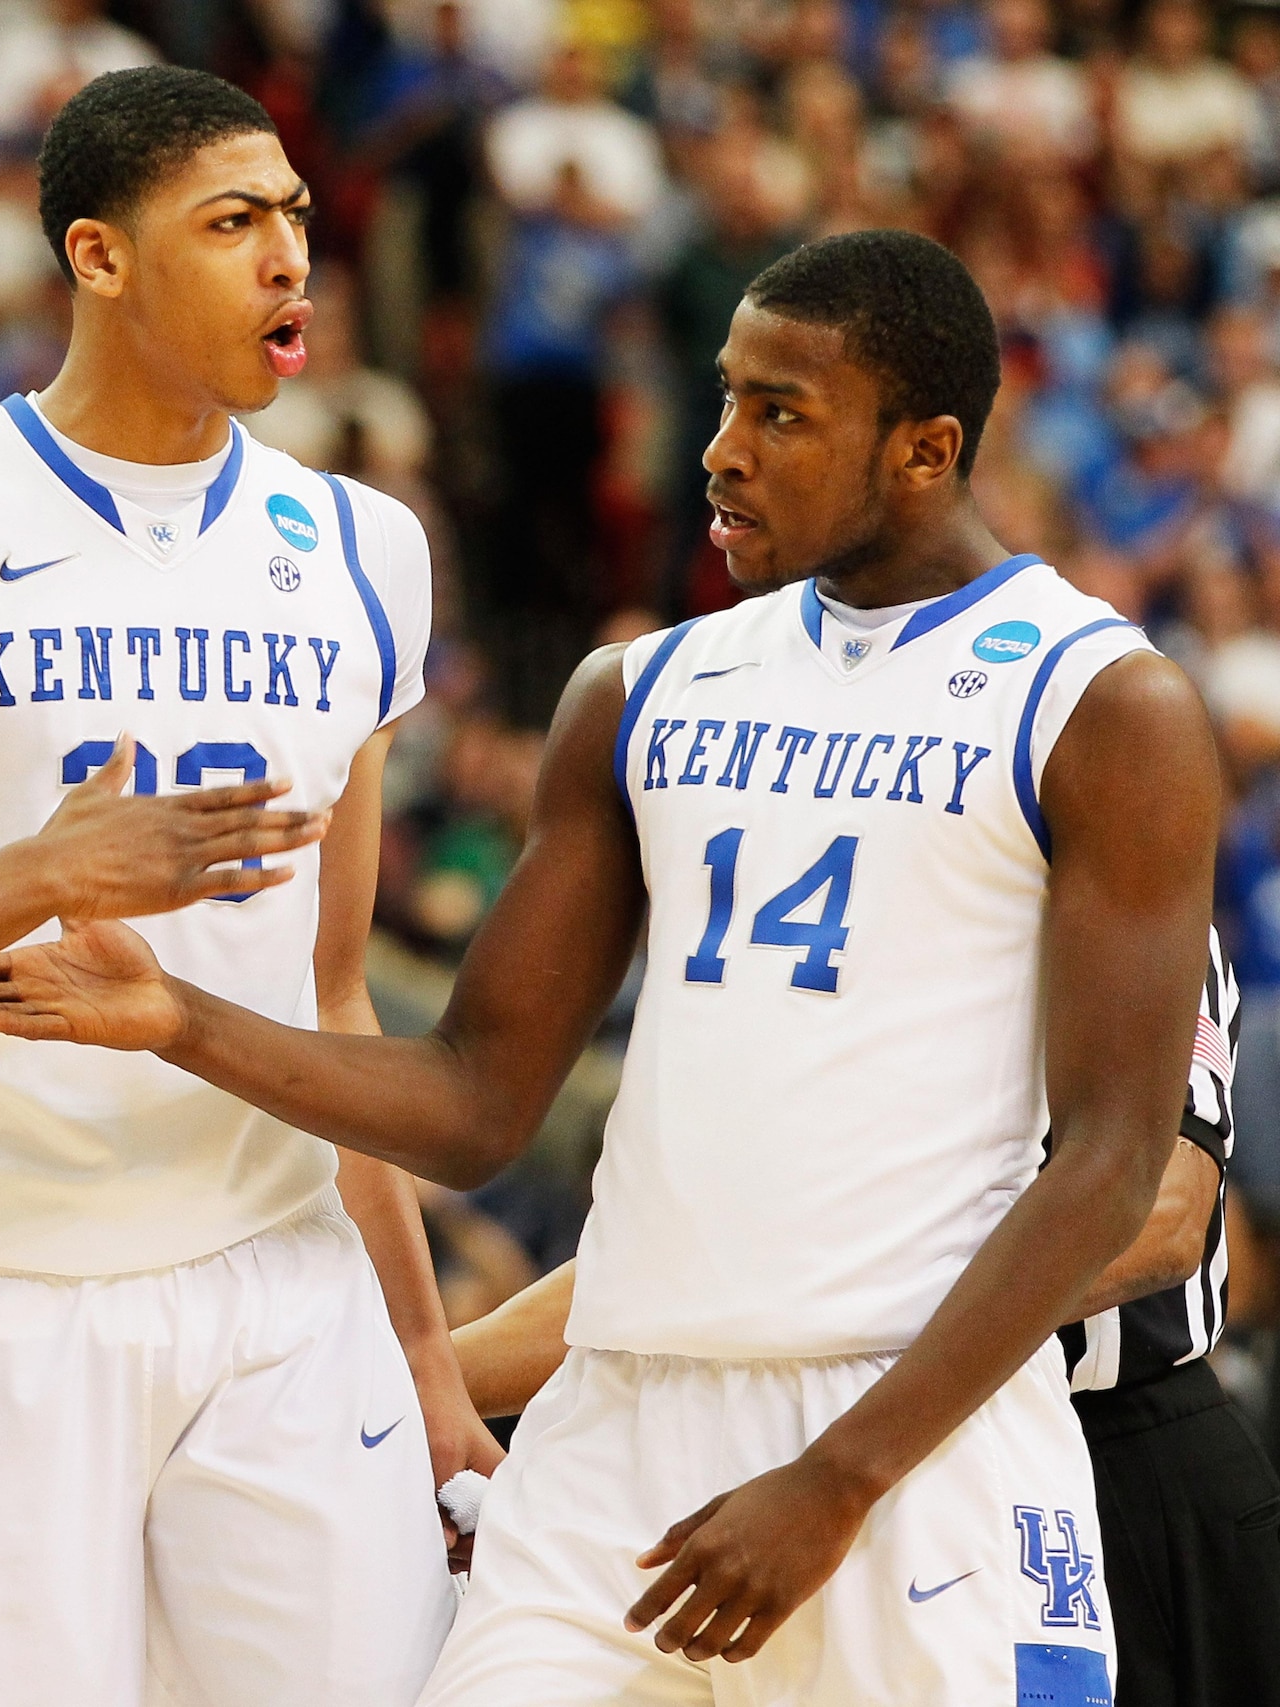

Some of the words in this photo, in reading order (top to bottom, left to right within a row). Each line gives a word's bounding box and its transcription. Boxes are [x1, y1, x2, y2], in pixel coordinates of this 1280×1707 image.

[152, 525, 174, 543] UK
[275, 513, 318, 542] NCAA
[270, 556, 301, 592] SEC
[978, 636, 1033, 655] NCAA
[949, 670, 988, 698] SEC
[643, 718, 992, 816] KENTUCKY
[684, 826, 863, 995] 14
[1013, 1504, 1102, 1632] UK
